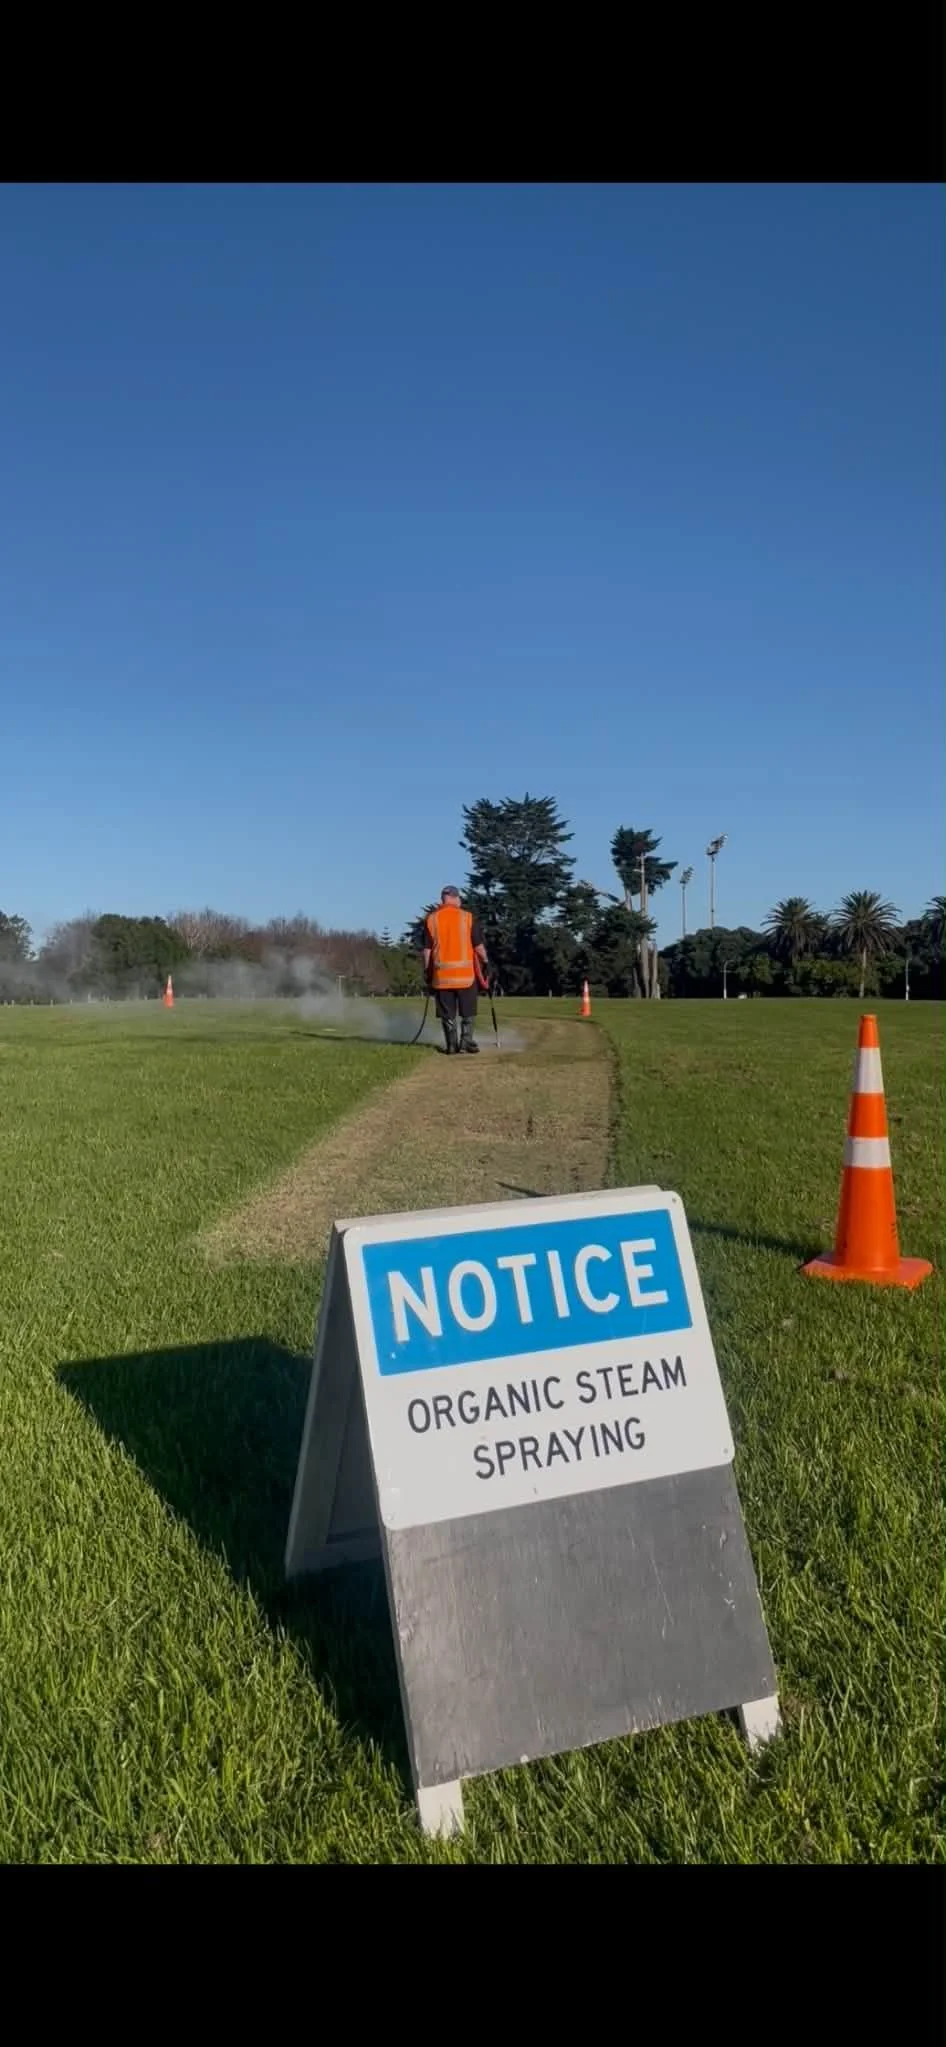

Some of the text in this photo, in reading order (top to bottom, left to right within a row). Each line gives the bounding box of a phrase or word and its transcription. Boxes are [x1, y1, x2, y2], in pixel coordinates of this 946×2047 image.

[387, 1238, 669, 1343] NOTICE
[407, 1355, 687, 1434] ORGANIC STEAM
[473, 1416, 646, 1480] SPRAYING
